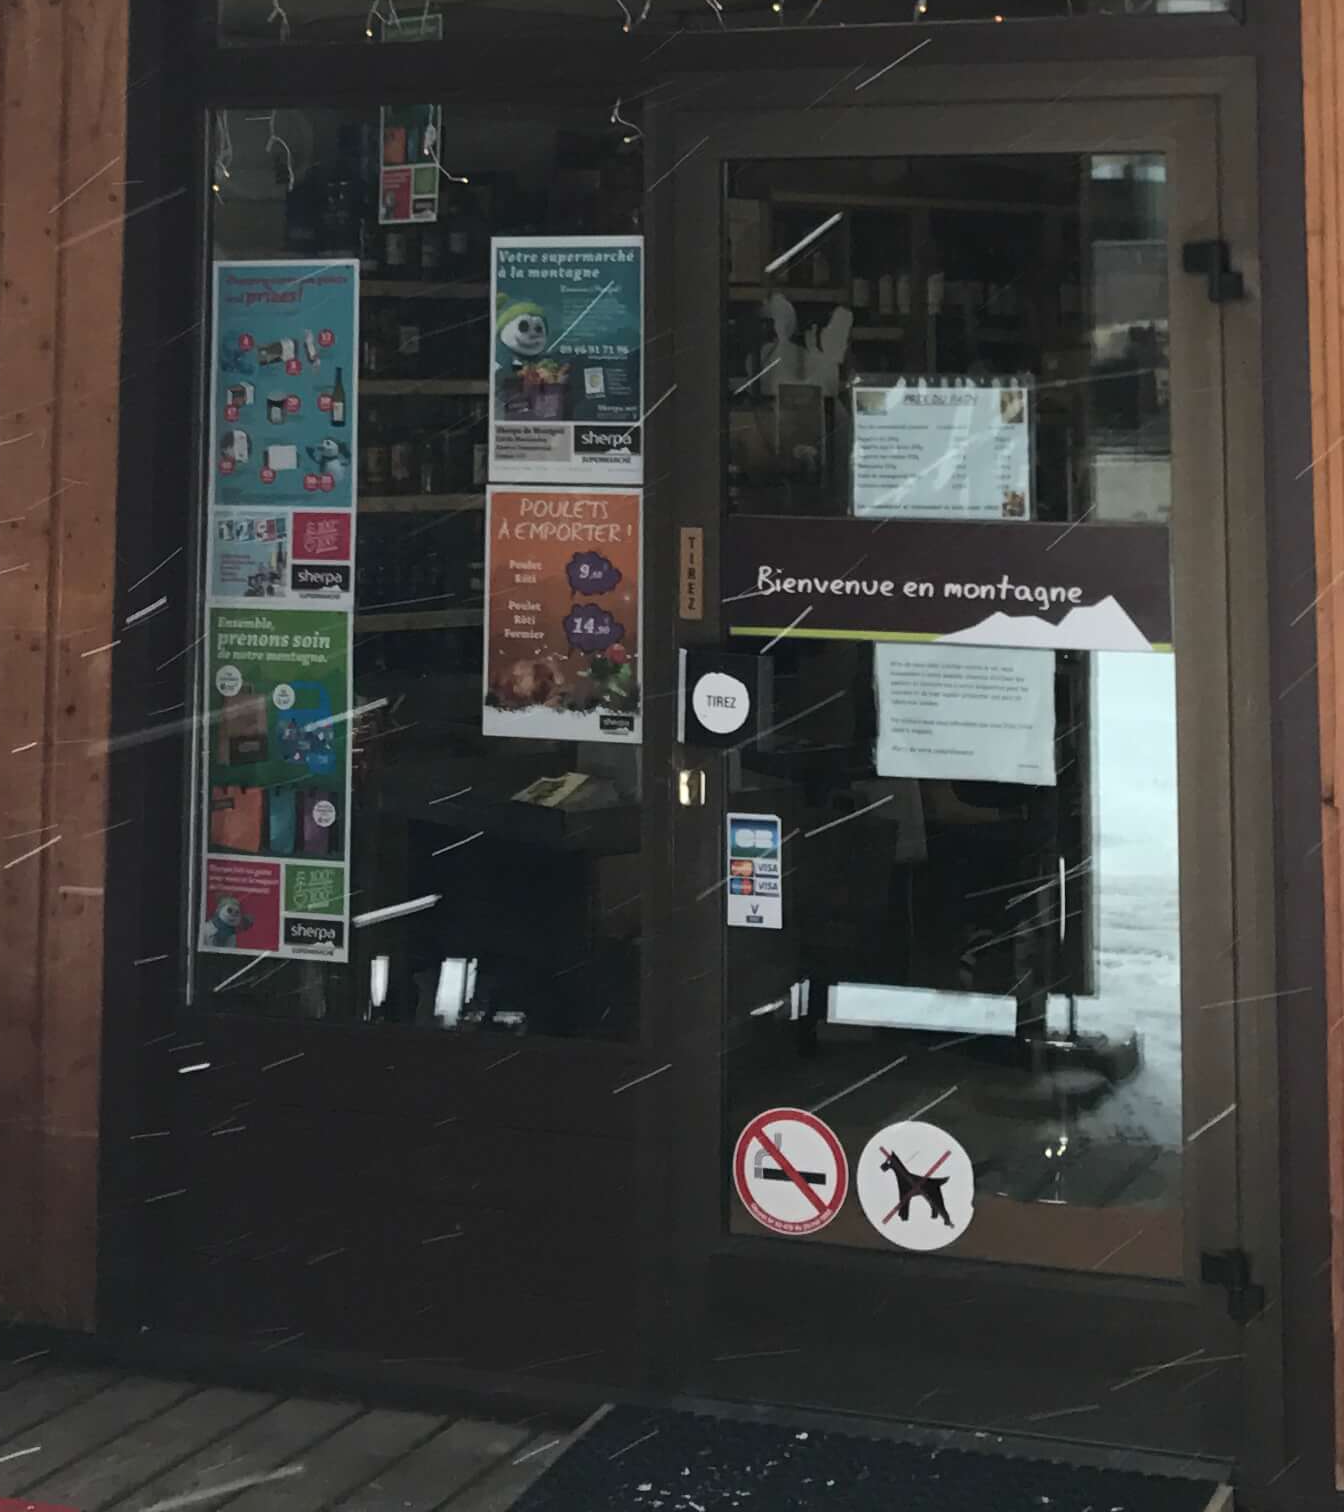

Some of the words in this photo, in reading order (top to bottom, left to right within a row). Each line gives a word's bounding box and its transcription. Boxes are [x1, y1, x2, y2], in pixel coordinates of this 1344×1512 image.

[499, 250, 539, 263] Votre
[542, 249, 635, 265] supermarché
[510, 266, 525, 279] la
[528, 267, 601, 282] montagne
[581, 430, 632, 447] sherpa
[520, 498, 609, 519] POULETS
[514, 522, 622, 542] EMPORTER
[297, 569, 343, 585] sherpa
[757, 565, 894, 597] Bienvenue
[903, 579, 934, 598] en
[943, 574, 1083, 611] montagne
[217, 616, 274, 630] Ensemble,
[217, 632, 289, 649] prenons
[292, 631, 331, 649] soin
[706, 695, 736, 709] TIREZ
[735, 829, 773, 848] CB
[759, 864, 778, 873] VISA
[759, 882, 778, 891] VISA
[290, 923, 336, 940] sherpa
